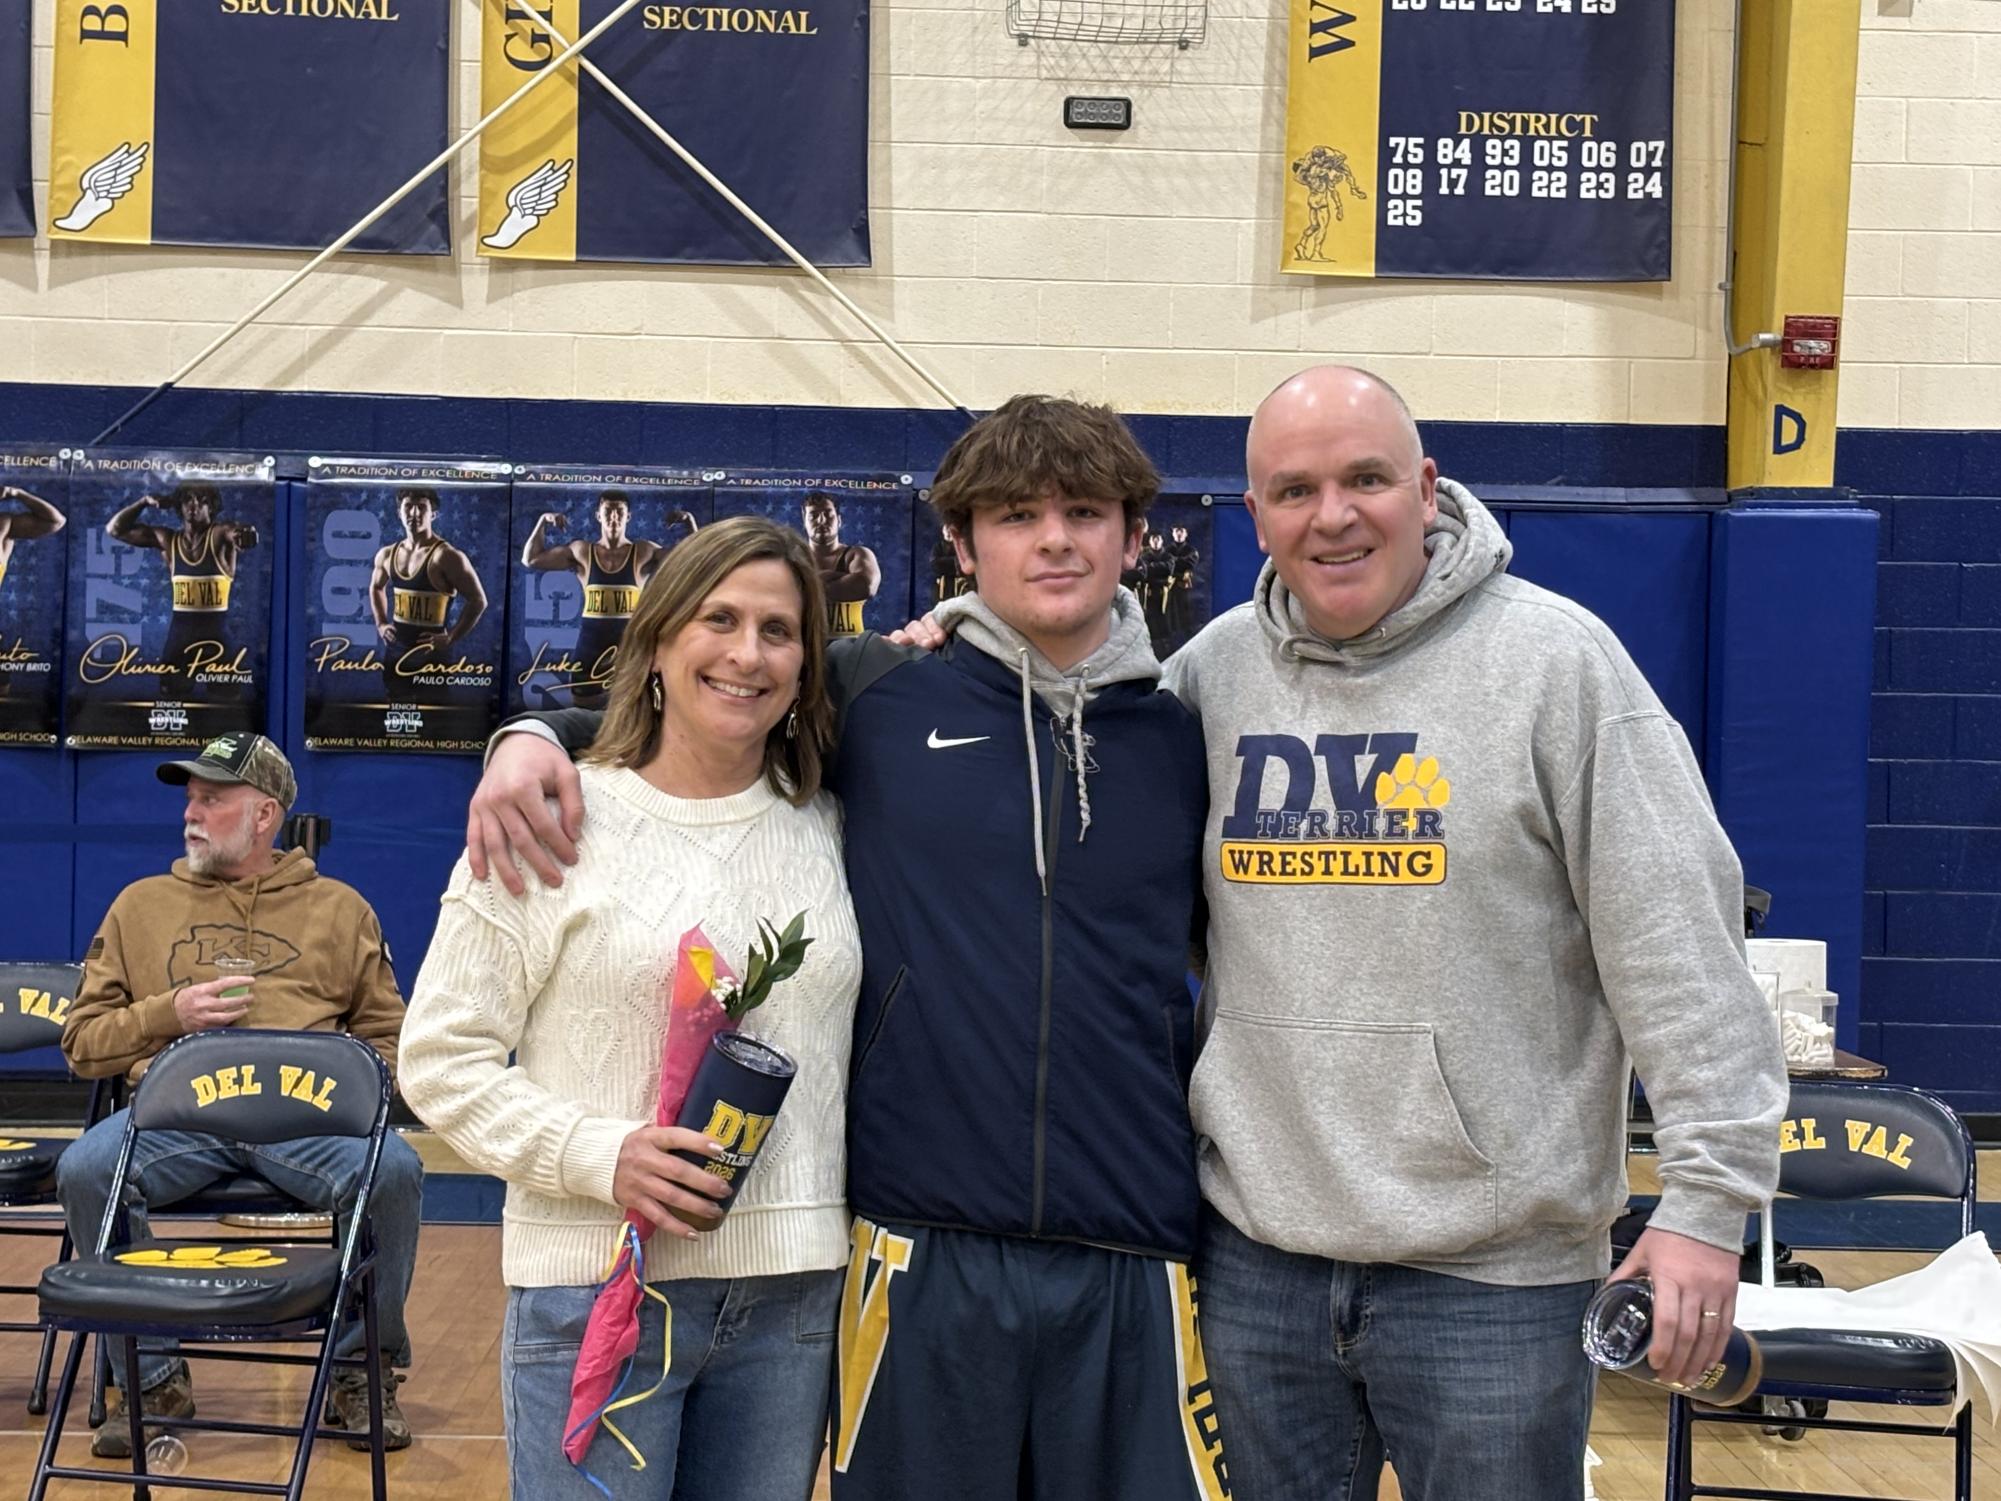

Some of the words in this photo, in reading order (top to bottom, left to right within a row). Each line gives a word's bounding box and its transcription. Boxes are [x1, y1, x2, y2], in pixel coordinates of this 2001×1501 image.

[220, 0, 400, 21] SECTIONAL
[642, 5, 818, 35] SECTIONAL
[1457, 111, 1598, 138] DISTRICT
[1388, 136, 1424, 164] 75
[1437, 138, 1471, 165] 84
[1485, 139, 1521, 166] 93
[1533, 140, 1569, 168] 05
[1581, 140, 1617, 168] 06
[1629, 140, 1665, 168] 07
[1387, 167, 1423, 195] 08
[1438, 168, 1468, 195] 17
[1484, 169, 1520, 197] 20
[1531, 170, 1568, 198] 22
[1579, 171, 1616, 199] 23
[1627, 171, 1663, 199] 24
[1387, 199, 1423, 226] 25
[1772, 403, 1807, 455] D
[84, 459, 94, 470] A
[98, 459, 160, 471] TRADITION
[164, 461, 183, 473] OF
[322, 466, 332, 474] A
[335, 466, 398, 476] TRADITION
[401, 467, 418, 477] OF
[422, 468, 497, 480] EXCELLENCE
[527, 473, 536, 481] A
[540, 473, 601, 482] TRADITION
[605, 474, 622, 483] OF
[625, 475, 700, 485] EXCELLENCE
[740, 478, 801, 486] TRADITION
[805, 479, 822, 487] OF
[825, 479, 898, 490] EXCELLENCE
[175, 582, 195, 606] DEL
[198, 581, 223, 606] VAL
[587, 590, 608, 613] DEL
[394, 594, 404, 617] EL
[408, 595, 432, 622] VAL
[26, 662, 51, 673] BRITO
[183, 640, 252, 678] Paul
[395, 643, 493, 676] Cardoso
[518, 641, 583, 685] Luke
[196, 673, 229, 683] OLIVIER
[231, 673, 253, 684] PAUL
[413, 675, 444, 685] PAULO
[446, 676, 492, 687] CARDOSO
[391, 703, 417, 711] SENIOR
[122, 736, 152, 746] VALLEY
[155, 737, 200, 747] REGIONAL
[357, 738, 388, 748] VALLEY
[390, 739, 434, 749] REGIONAL
[437, 740, 458, 749] HIGH
[1221, 733, 1419, 840] DV
[1256, 808, 1445, 840] TERRIER
[1228, 849, 1433, 878] WRESTLING
[18, 988, 71, 1027] VAL
[190, 1064, 262, 1109] DEL
[279, 1064, 338, 1113] VAL
[702, 1099, 776, 1156] DV
[1779, 1118, 1826, 1153] EL
[1844, 1119, 1914, 1170] VAL
[704, 1160, 736, 1181] 2026
